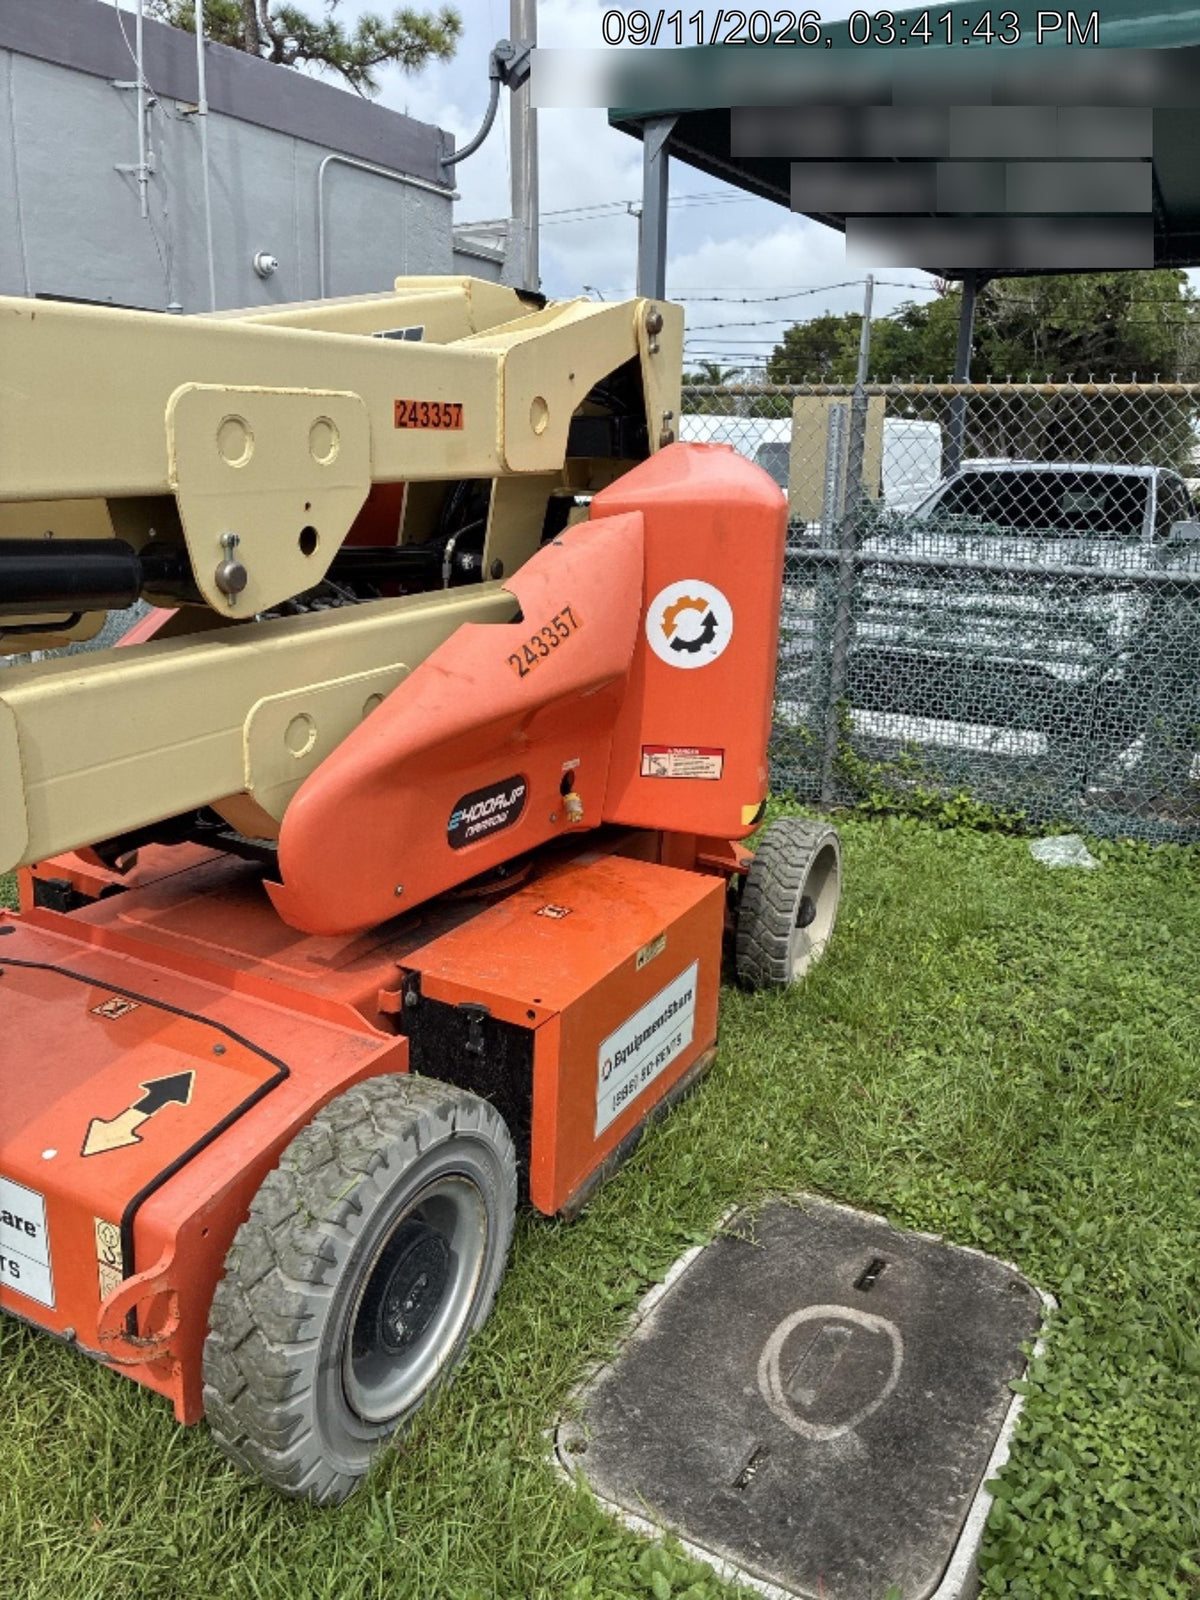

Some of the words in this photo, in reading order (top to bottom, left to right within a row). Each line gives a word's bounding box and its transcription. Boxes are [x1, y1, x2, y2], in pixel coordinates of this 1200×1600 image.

[398, 400, 463, 428] 243357
[508, 605, 578, 678] 243357
[614, 988, 692, 1069] EquipmentShare
[0, 1209, 37, 1238] are
